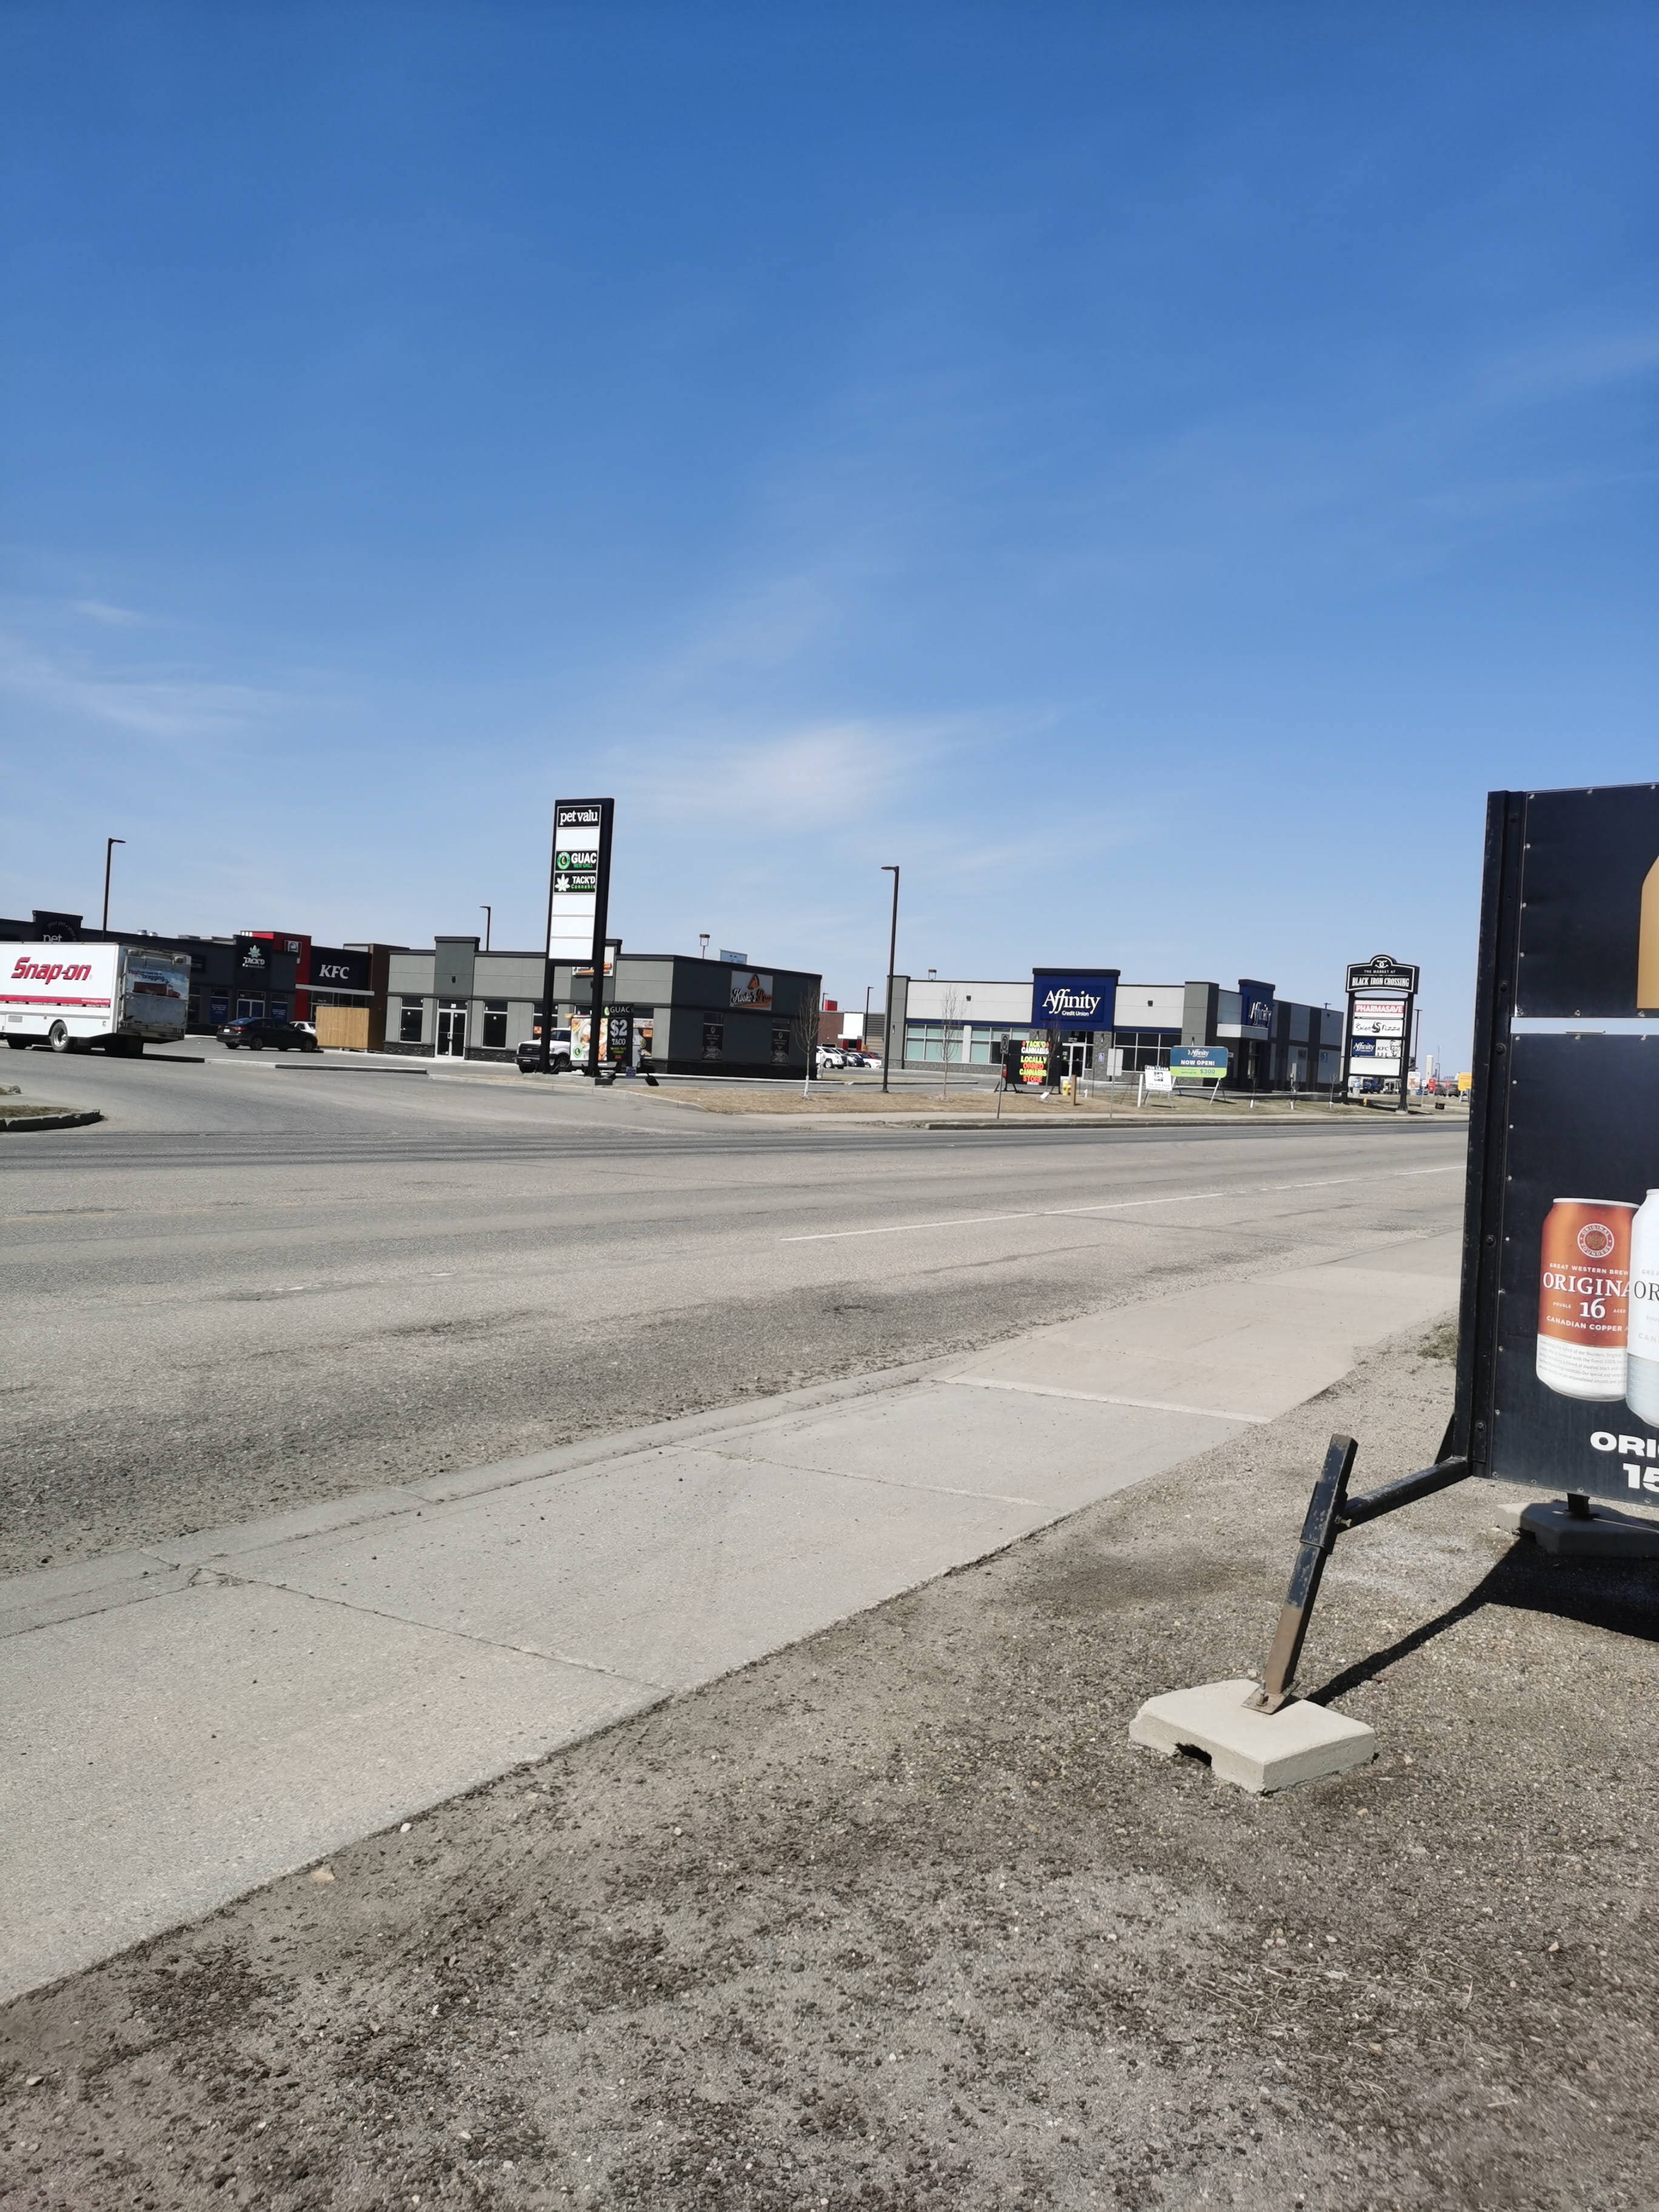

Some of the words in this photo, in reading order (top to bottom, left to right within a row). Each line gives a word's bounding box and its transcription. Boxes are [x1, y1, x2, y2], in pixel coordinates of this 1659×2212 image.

[559, 810, 576, 825] pet
[577, 809, 598, 822] valu
[571, 853, 597, 864] GUAC
[572, 876, 595, 885] TACK'D
[11, 957, 92, 985] Snap-on
[319, 964, 350, 979] KFC
[1352, 977, 1369, 987] BLACK
[1370, 977, 1383, 985] IRON
[1384, 977, 1410, 987] CROSSING
[1042, 988, 1101, 1014] Affinity
[610, 1019, 628, 1037] $2
[1190, 1049, 1209, 1057] Affinity
[1353, 1042, 1375, 1052] Affinity
[1021, 1056, 1047, 1064] LOCALLY
[1581, 1225, 1610, 1236] ORIGINAL
[1580, 1243, 1612, 1256] FOUNDERS
[1571, 1265, 1607, 1274] WESTERN
[1579, 1298, 1606, 1319] 16
[1546, 1316, 1586, 1329] CANADIAN
[1590, 1431, 1659, 1458] ORI
